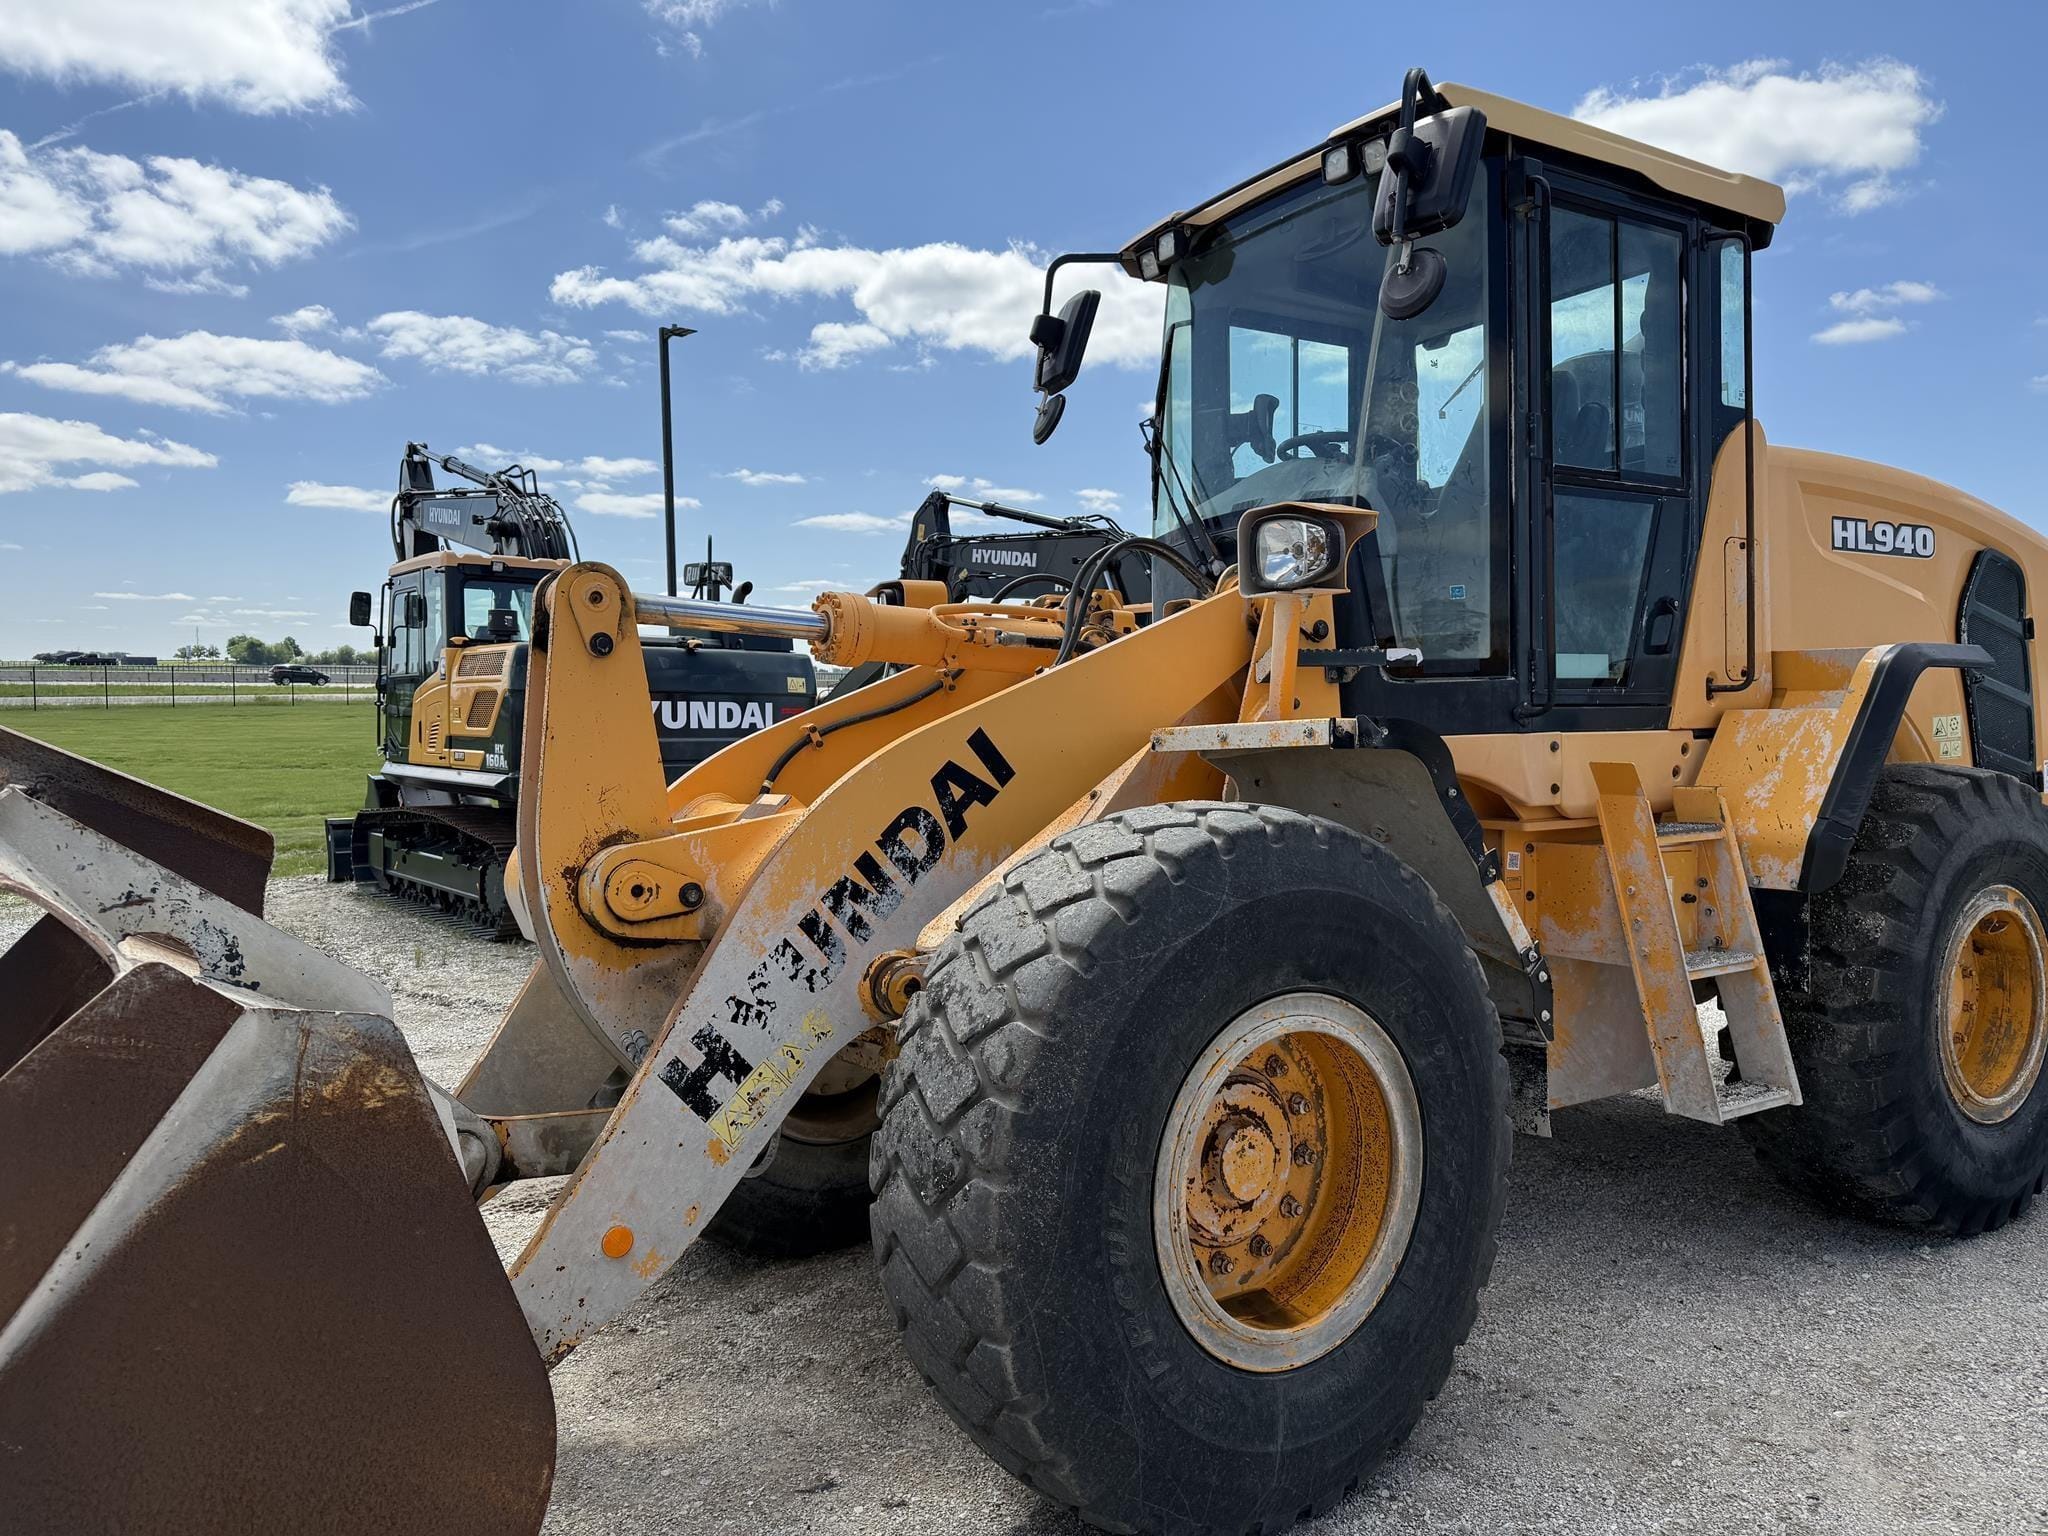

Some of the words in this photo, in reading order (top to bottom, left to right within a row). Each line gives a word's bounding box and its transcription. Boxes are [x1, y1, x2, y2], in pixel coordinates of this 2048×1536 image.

[429, 507, 460, 526] HYUNDAI
[1833, 519, 1934, 556] HL940
[972, 549, 1037, 567] HYUNDAI
[651, 701, 774, 729] UNDAI
[494, 743, 505, 754] HX
